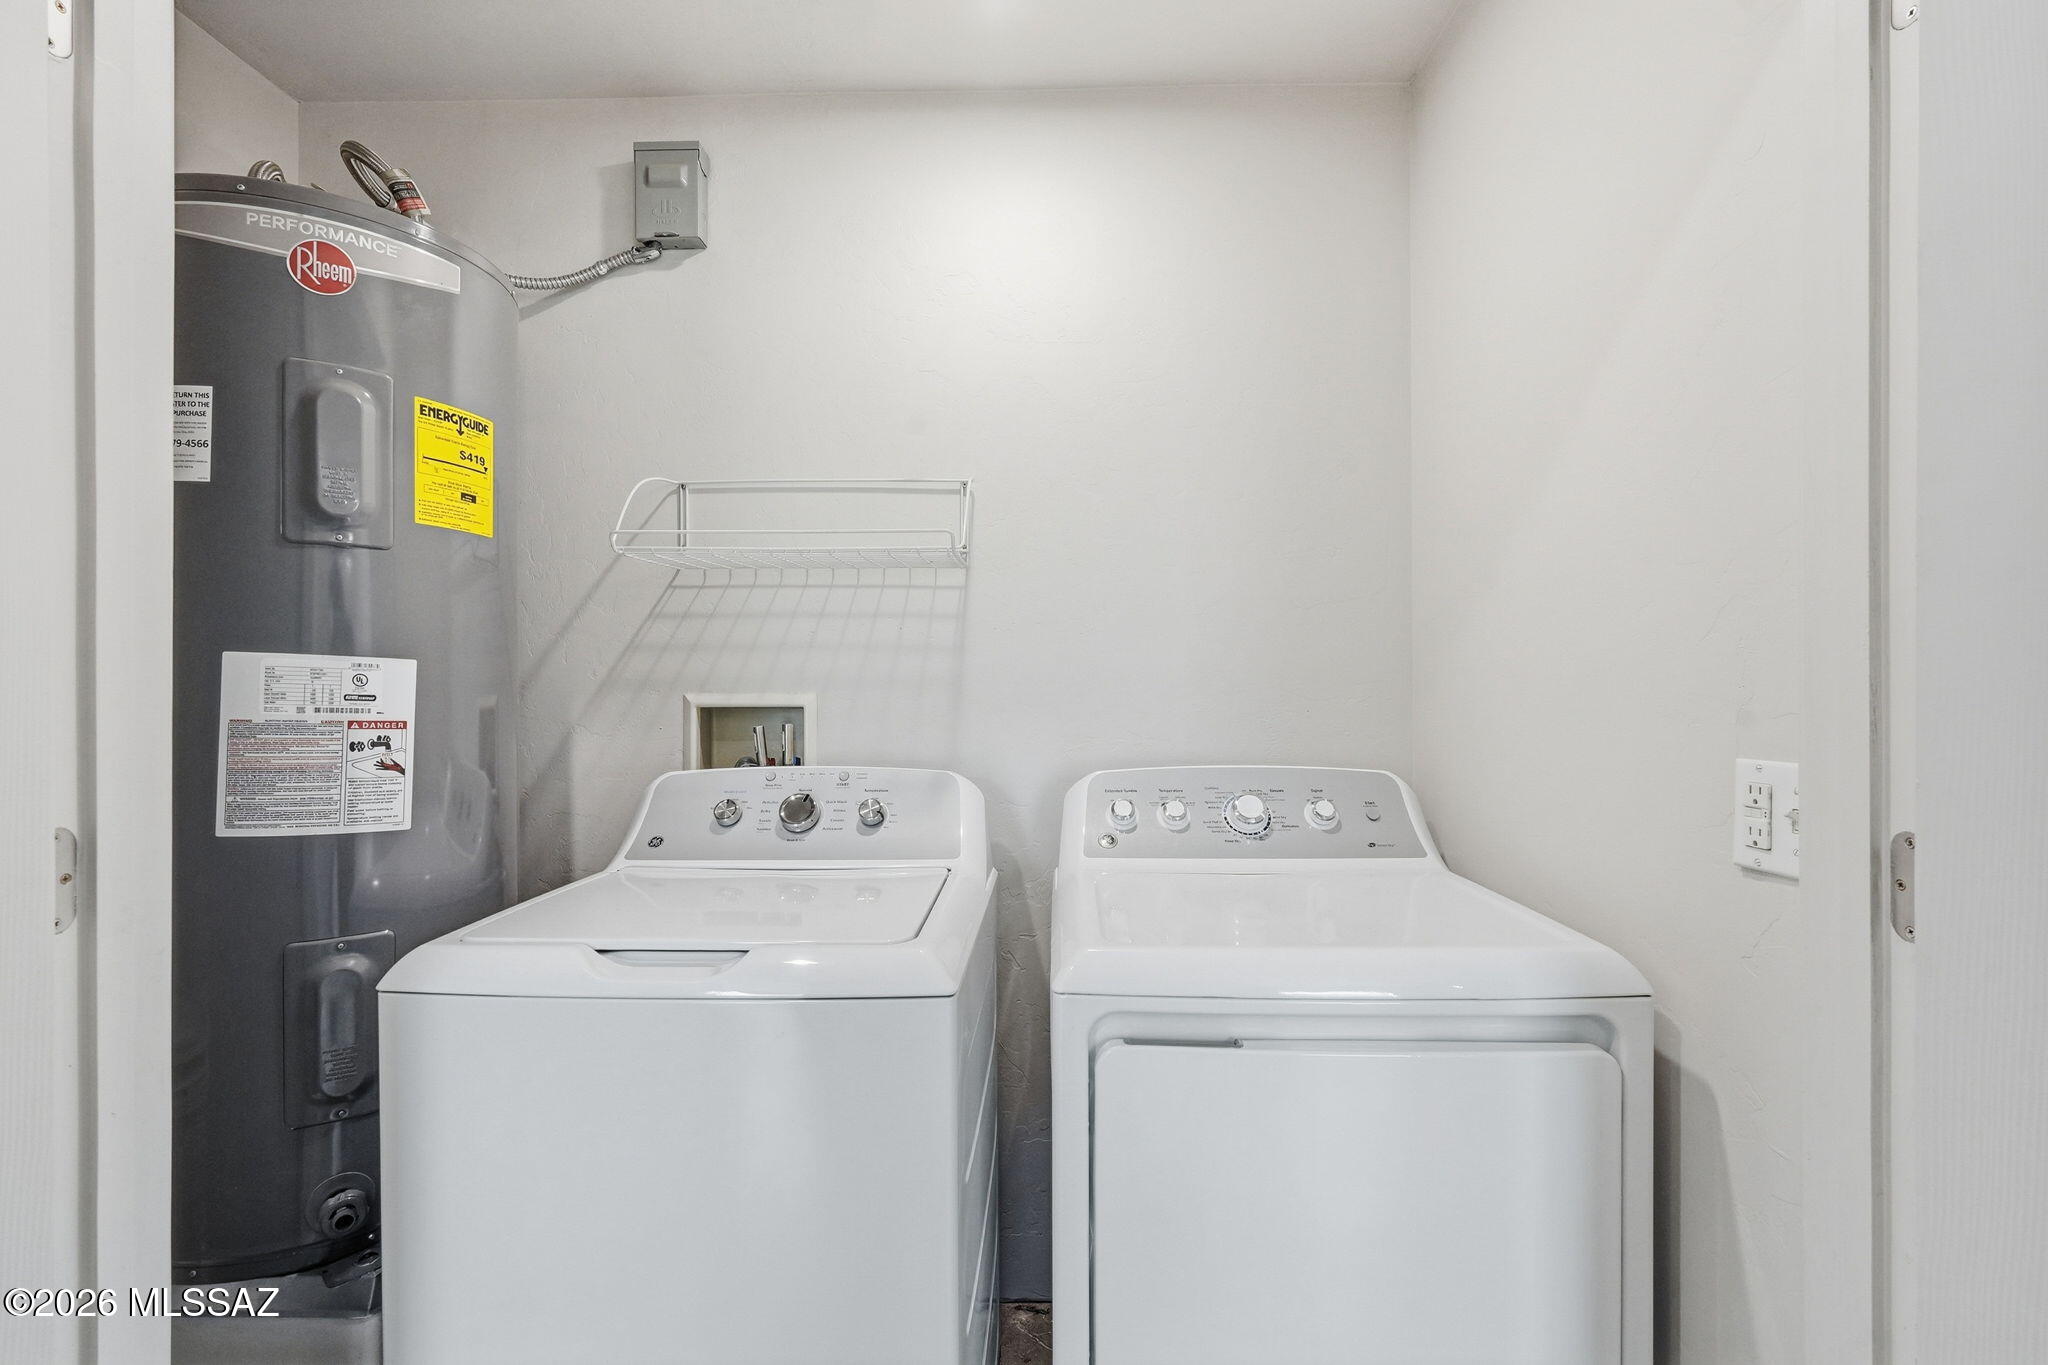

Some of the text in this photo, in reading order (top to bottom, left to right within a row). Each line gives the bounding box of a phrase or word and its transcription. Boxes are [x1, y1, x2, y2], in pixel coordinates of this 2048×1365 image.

[246, 212, 399, 258] PERFORMANCE
[296, 240, 353, 285] Rheem
[419, 403, 489, 436] ENERGYGUIDE
